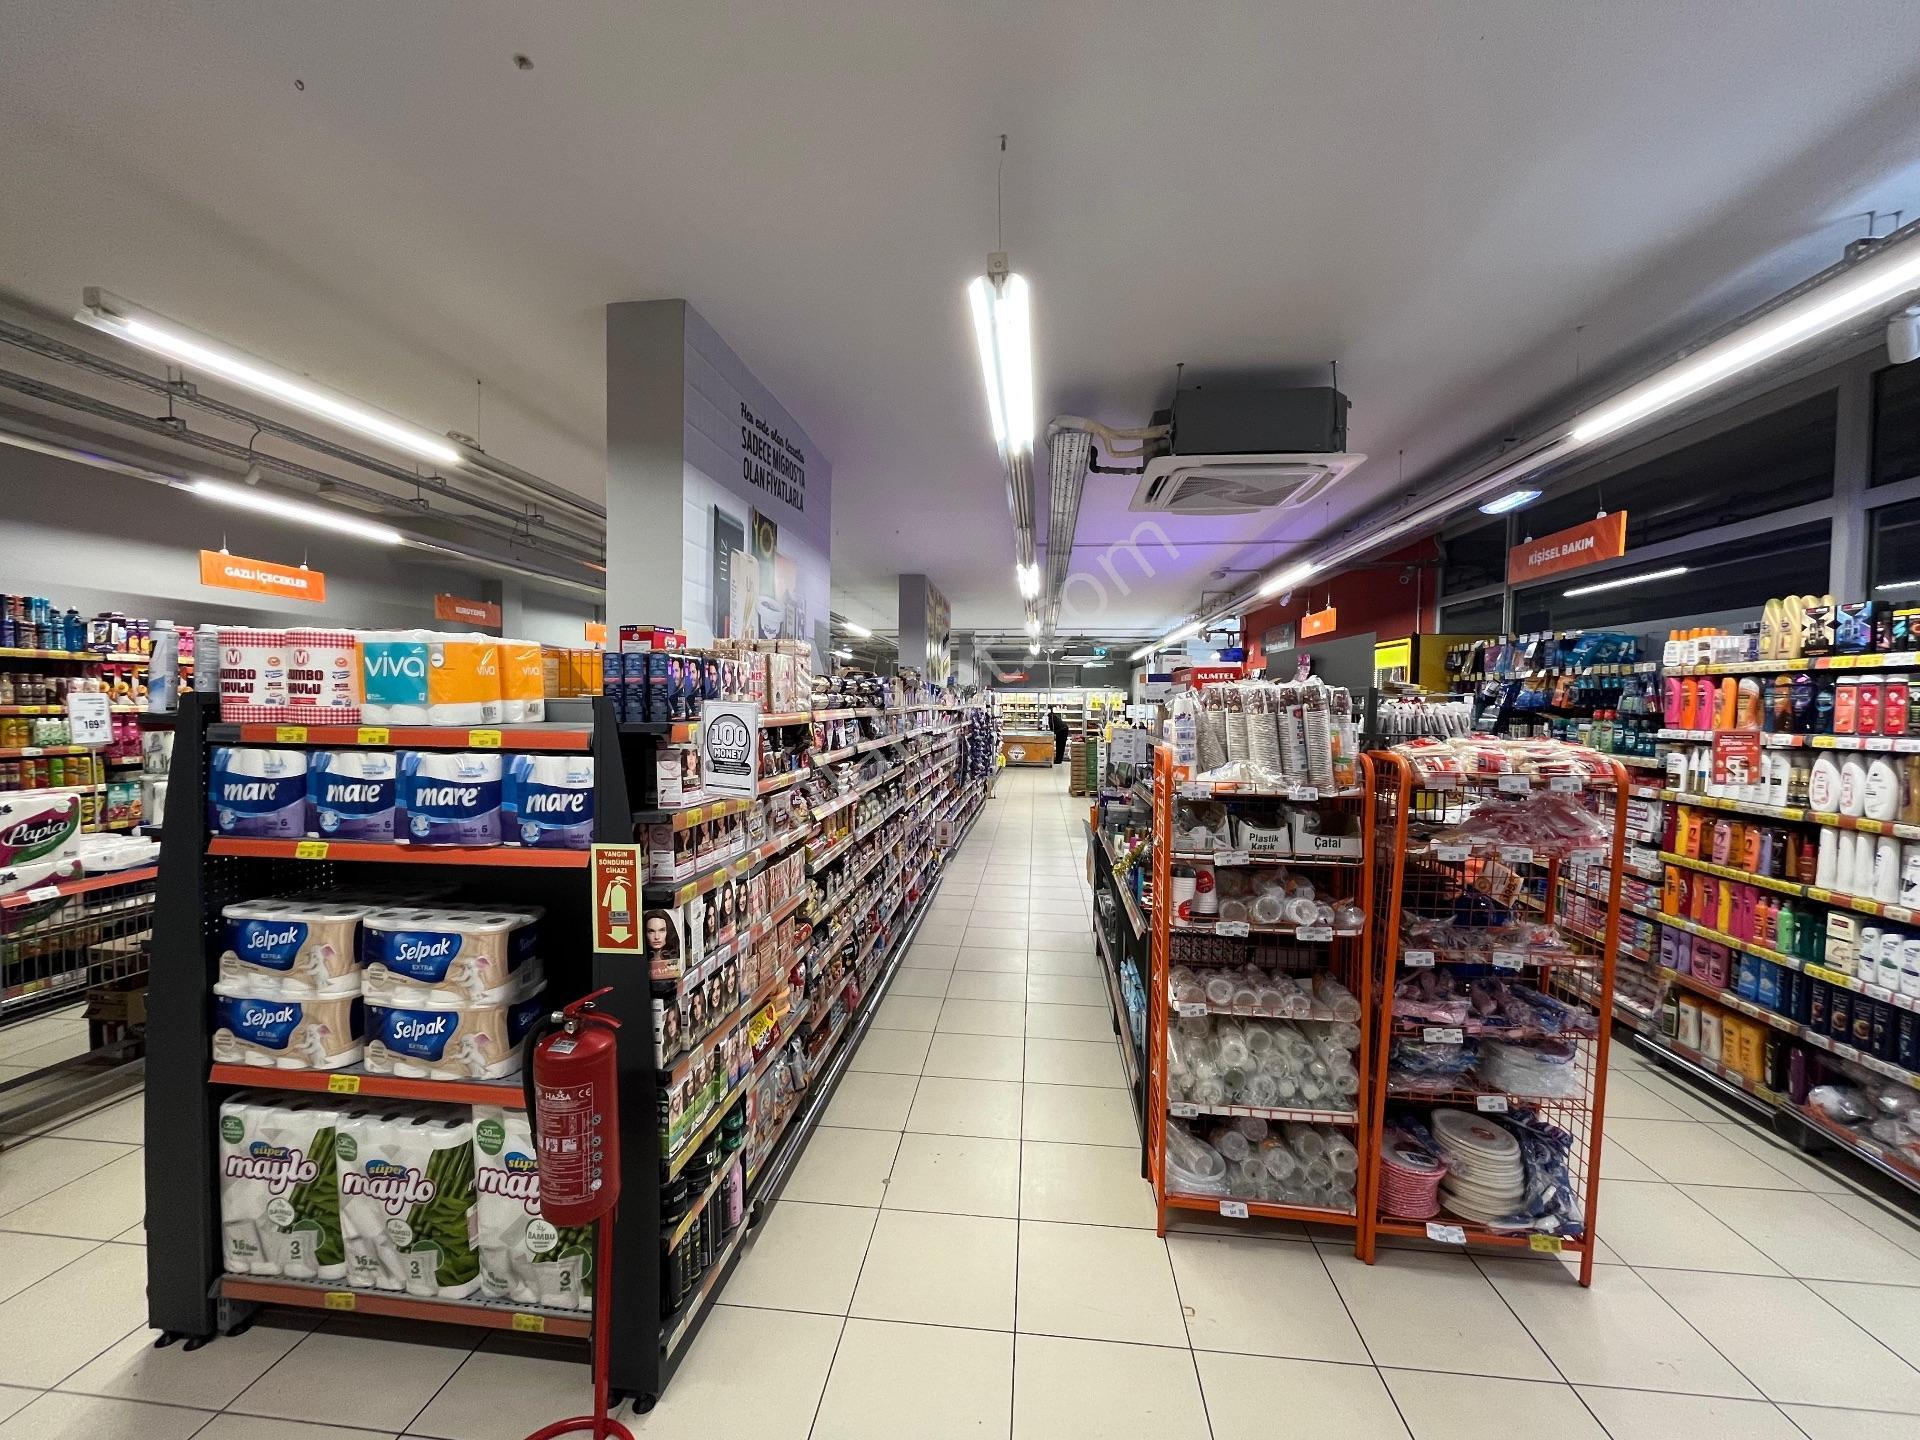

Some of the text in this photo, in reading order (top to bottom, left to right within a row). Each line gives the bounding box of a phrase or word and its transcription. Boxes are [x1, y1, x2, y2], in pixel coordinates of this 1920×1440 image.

[741, 426, 771, 466] SADECE
[743, 456, 804, 513] OLAN FİYATLARLA
[1528, 535, 1594, 566] KİŞİSEL BAKIM
[224, 566, 308, 589] GAZLI İÇECEKLER
[364, 651, 425, 677] viva
[477, 666, 496, 676] viva
[522, 666, 541, 676] viva
[1197, 672, 1237, 680] KUMTEL
[711, 723, 748, 748] 100
[714, 747, 744, 761] MONEY
[223, 782, 277, 801] mare
[325, 783, 381, 803] mare
[416, 786, 477, 808] mare
[526, 792, 584, 814] mare
[11, 818, 69, 846] Papia
[1249, 832, 1280, 844] Plastik
[1251, 841, 1276, 852] Kaşık
[1314, 837, 1342, 850] Çatal
[598, 857, 635, 867] SÖNDÜRME
[603, 850, 629, 858] YANGIN
[605, 866, 628, 875] CİHAZI
[247, 927, 298, 950] Selpak
[395, 937, 451, 962] Selpak
[411, 963, 434, 972] EXTRA
[242, 1006, 293, 1029] Selpak
[393, 1015, 446, 1042] Selpak
[226, 1149, 319, 1195] maylo
[342, 1168, 436, 1216] maylo
[527, 1231, 556, 1241] BAMBU
[290, 1240, 301, 1255] 3
[410, 1260, 420, 1275] 3
[559, 1270, 571, 1286] 3
